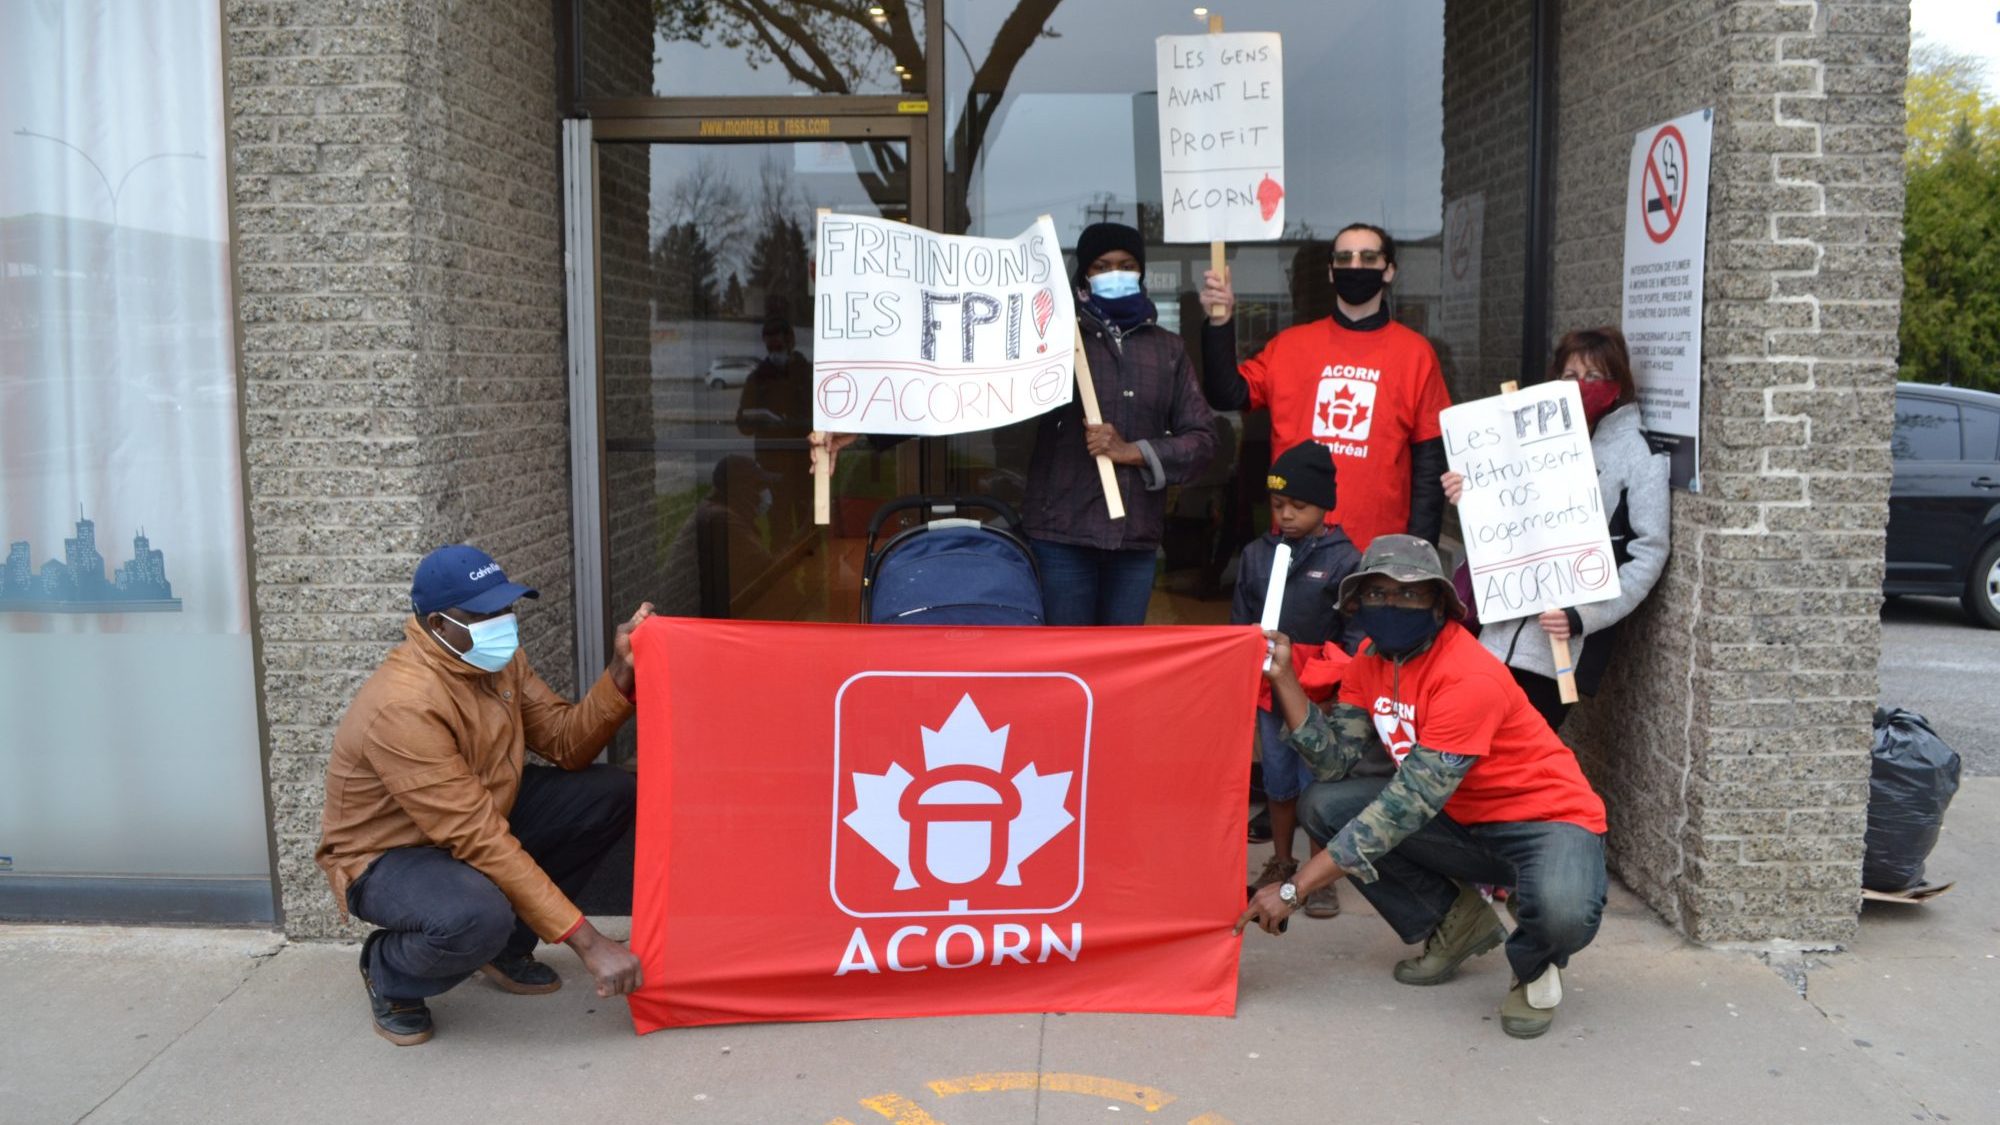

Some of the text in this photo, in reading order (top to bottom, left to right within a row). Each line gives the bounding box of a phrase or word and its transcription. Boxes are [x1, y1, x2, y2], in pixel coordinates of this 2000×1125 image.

[1174, 44, 1268, 69] LES GENS
[1168, 80, 1270, 107] AVANT LE
[1171, 184, 1254, 214] ACORN
[820, 221, 1051, 286] FREINONS
[822, 291, 901, 339] LES
[1321, 364, 1381, 382] ACORN
[860, 376, 1014, 423] ACORN
[1314, 440, 1369, 459] ntréal
[1444, 396, 1573, 457] Les FPI
[1462, 443, 1584, 492] détruisent
[1498, 480, 1540, 507] nos
[1482, 559, 1576, 616] ACORN
[833, 922, 1083, 977] ACORN
